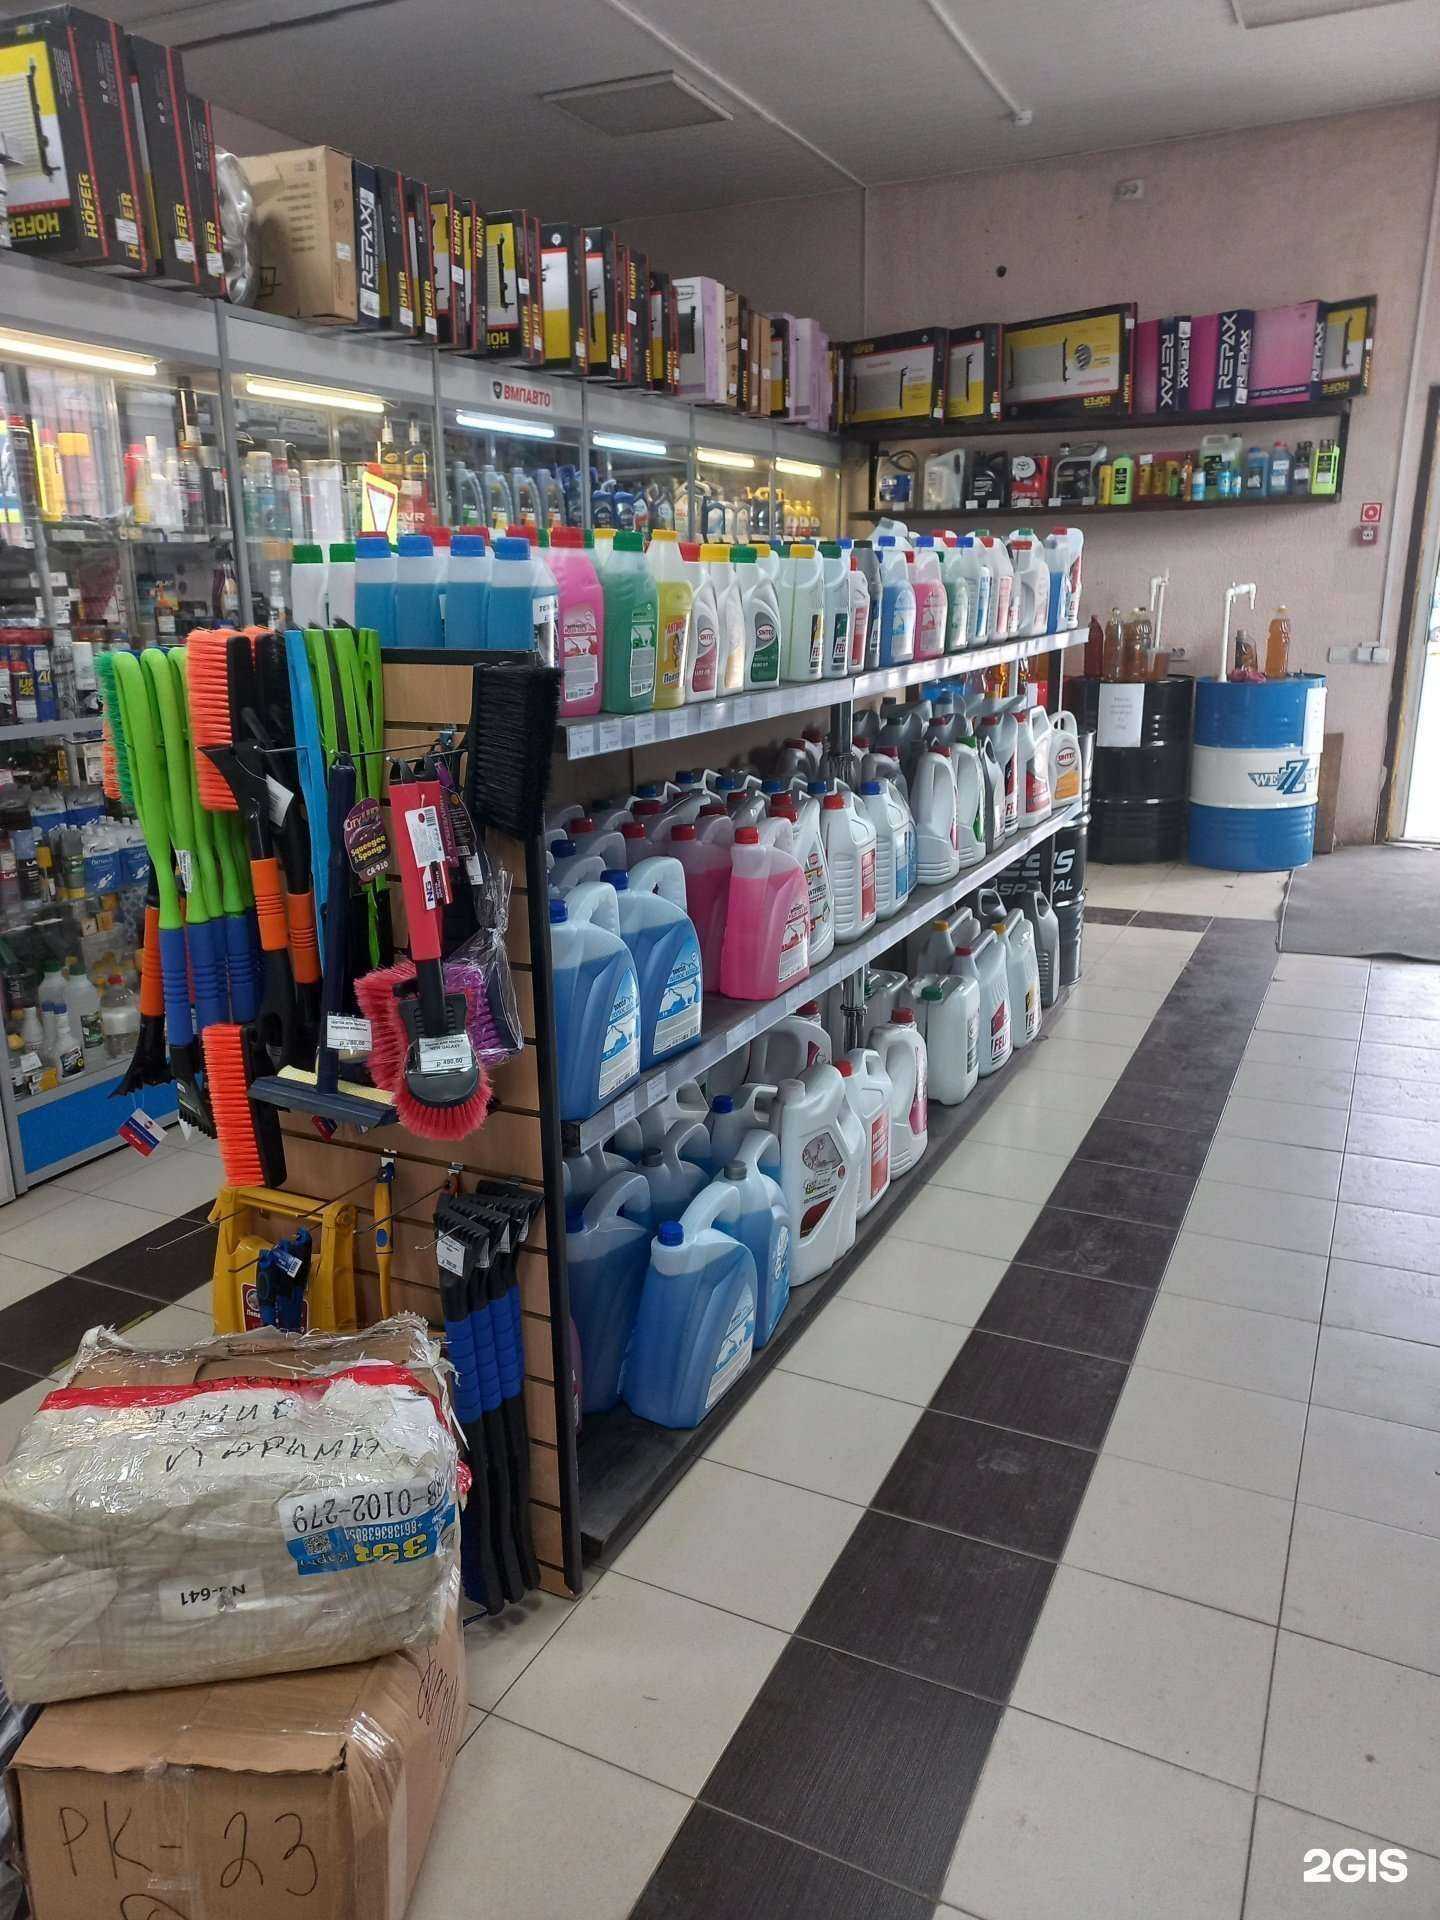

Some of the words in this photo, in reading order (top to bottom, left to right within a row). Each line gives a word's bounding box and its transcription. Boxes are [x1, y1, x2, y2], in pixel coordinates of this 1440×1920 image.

[78, 172, 99, 239] HÖFER
[118, 192, 141, 261] HER
[1161, 334, 1175, 407] REPAX
[1218, 312, 1238, 390] REPAX
[503, 384, 551, 407] ВМПАВТО
